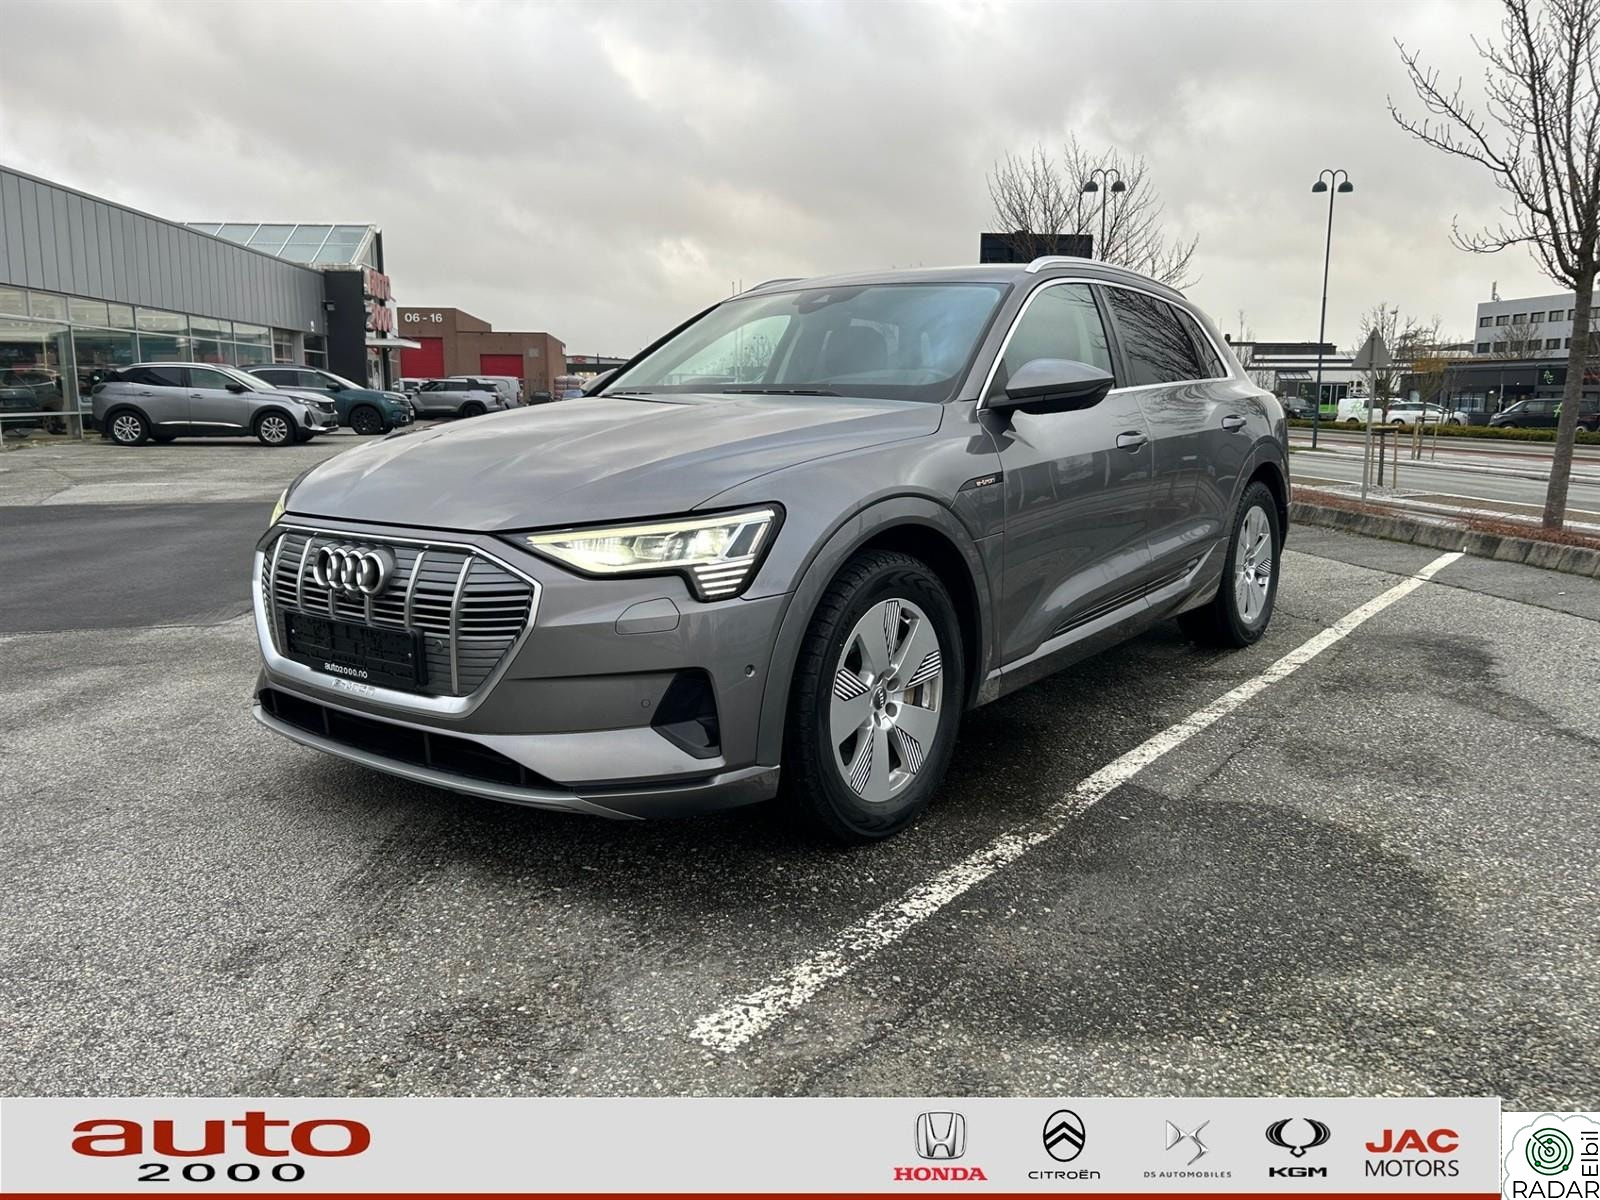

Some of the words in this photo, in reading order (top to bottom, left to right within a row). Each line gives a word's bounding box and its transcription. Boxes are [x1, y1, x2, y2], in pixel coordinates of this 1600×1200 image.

[365, 302, 392, 332] 2000
[404, 313, 420, 323] 06
[430, 313, 443, 323] 16
[324, 662, 368, 679] auto2000.no
